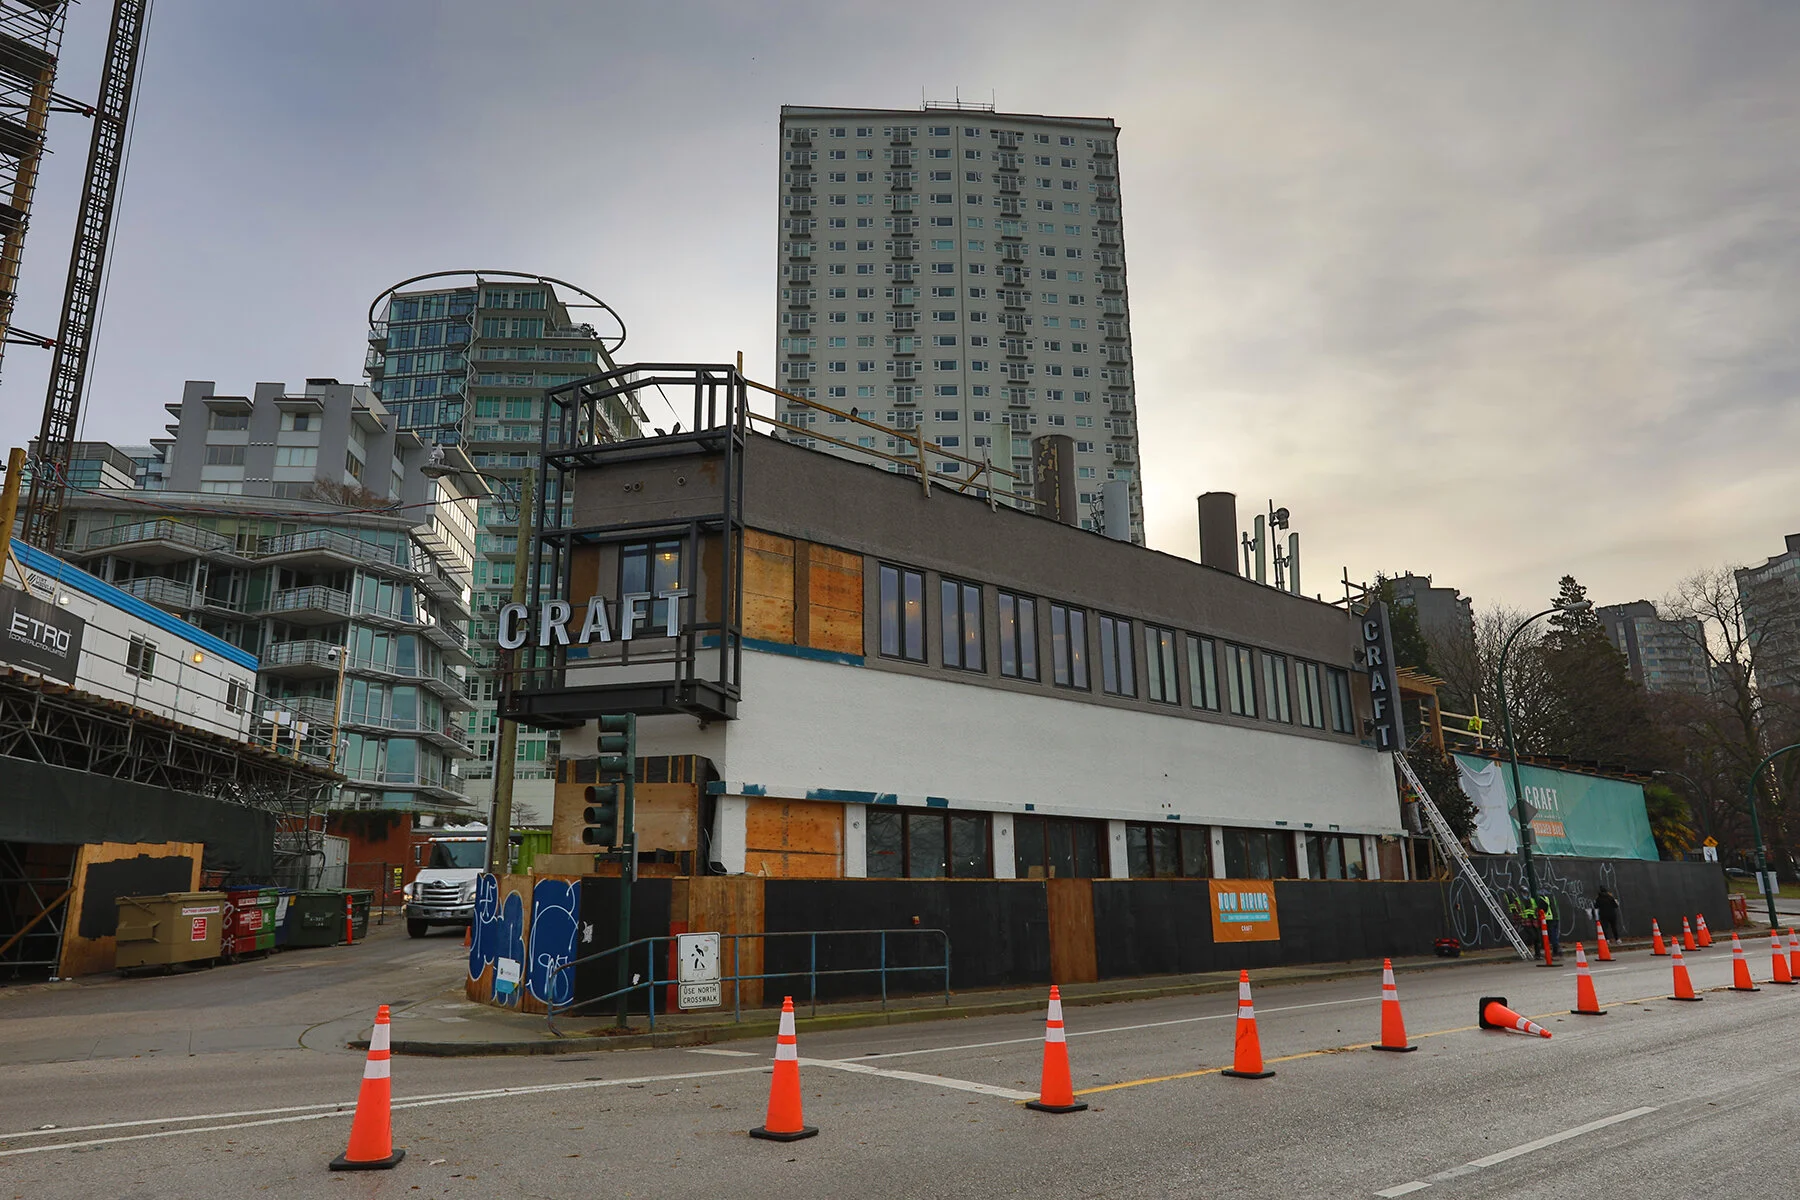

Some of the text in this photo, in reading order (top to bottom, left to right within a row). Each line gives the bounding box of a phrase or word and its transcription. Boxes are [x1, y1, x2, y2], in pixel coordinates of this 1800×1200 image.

[9, 609, 71, 652] ETRO
[498, 588, 689, 650] CRAFT
[1363, 620, 1391, 746] CRAFT
[1524, 786, 1559, 811] CRAFT
[1218, 892, 1269, 911] NOW HIRING
[682, 996, 718, 1004] CROSSWALK
[683, 986, 717, 995] USE NORTH
